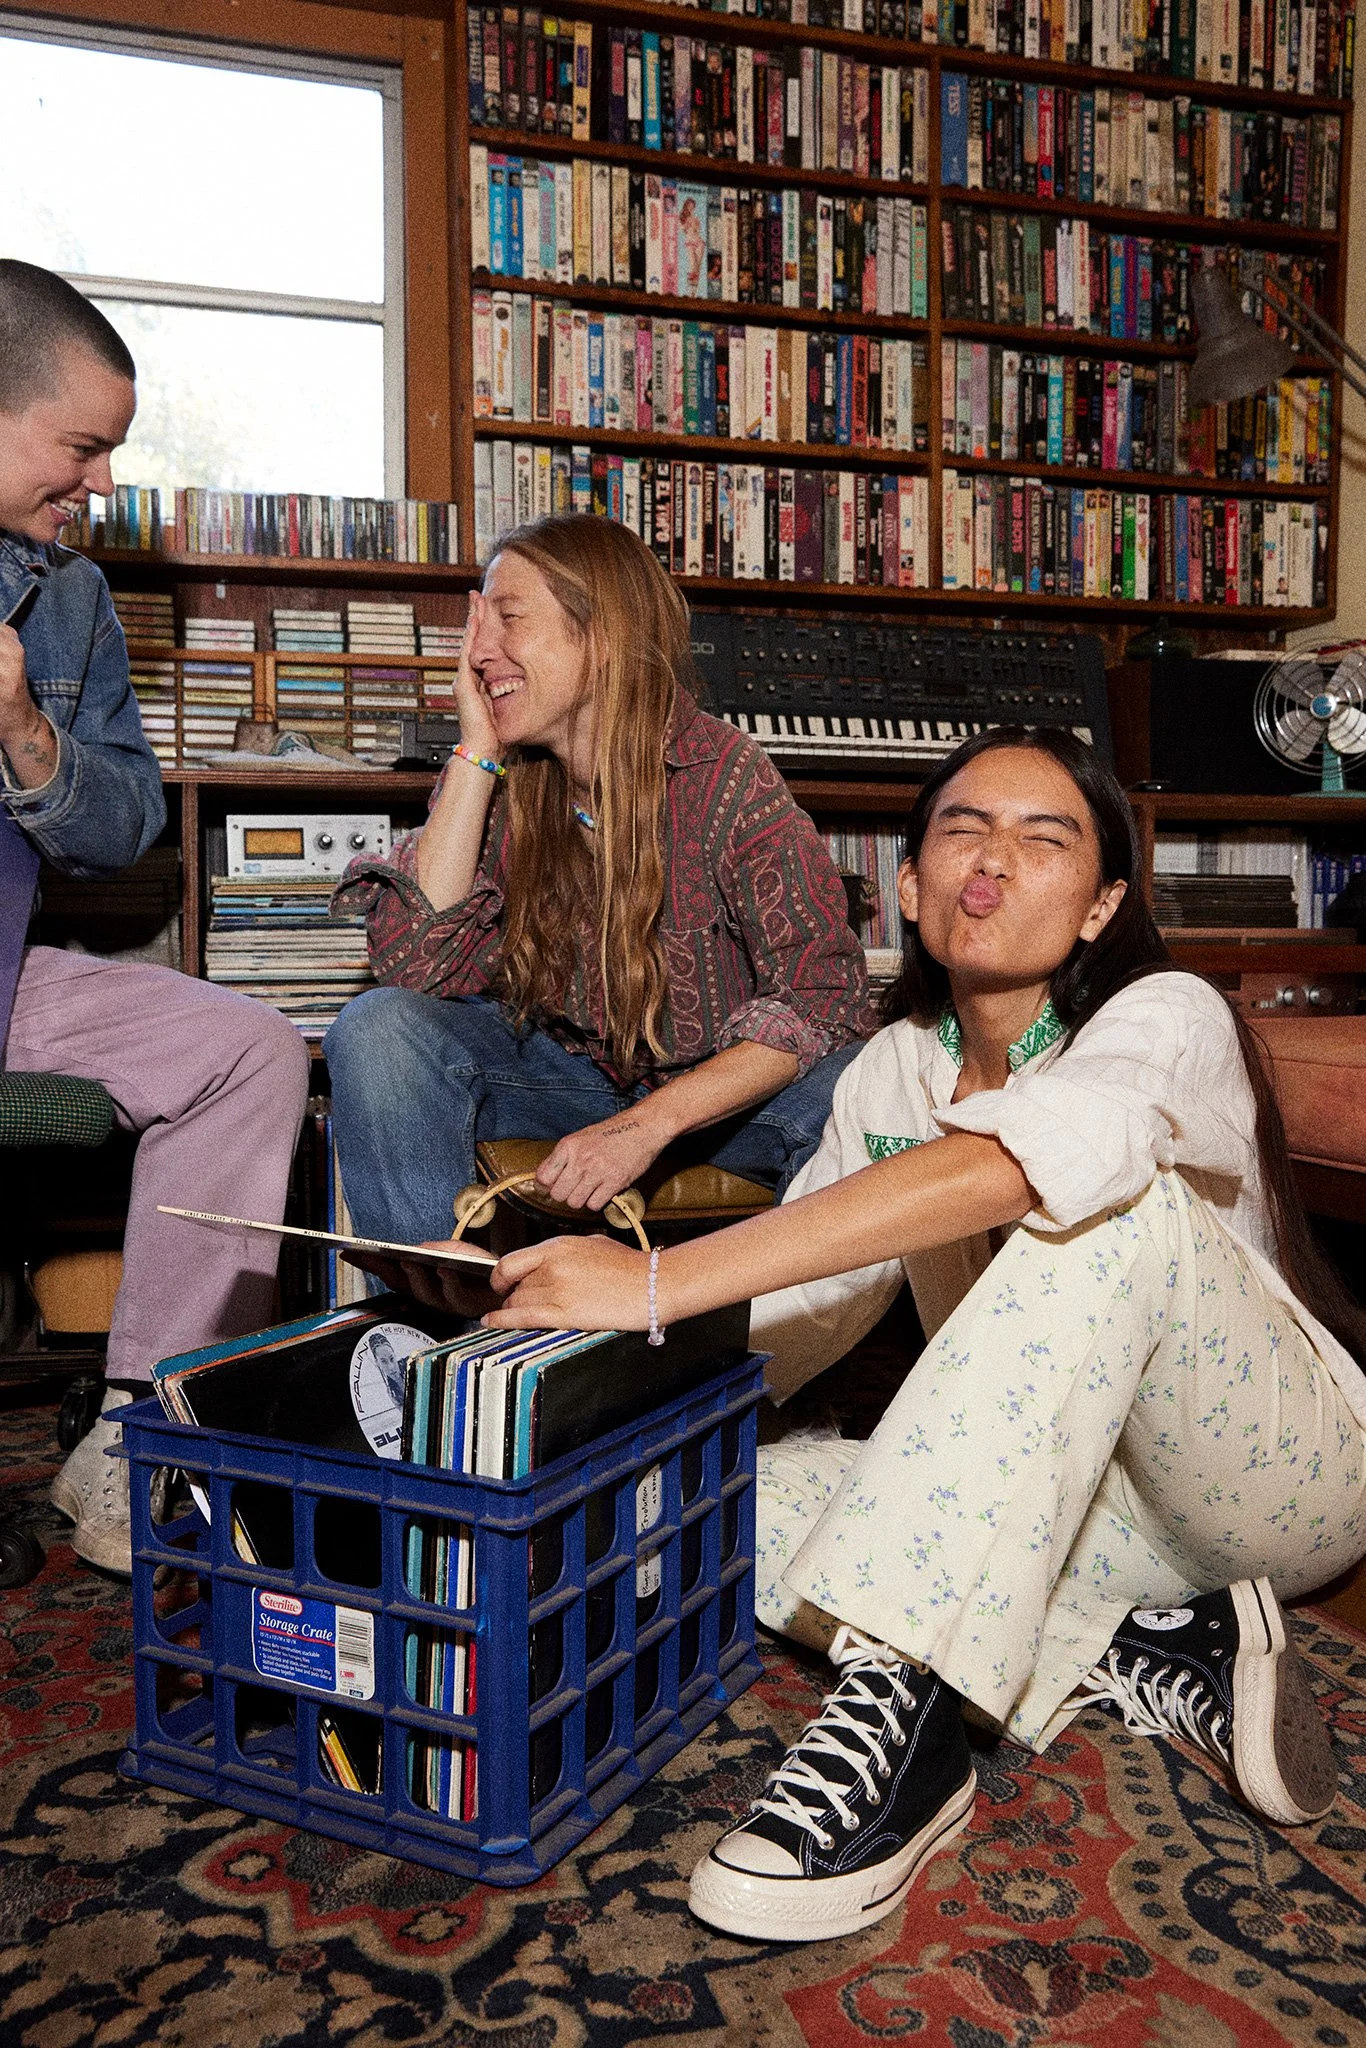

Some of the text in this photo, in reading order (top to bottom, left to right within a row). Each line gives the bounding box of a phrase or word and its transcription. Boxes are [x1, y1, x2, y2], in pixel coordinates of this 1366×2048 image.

[1316, 8, 1327, 62] DUNE
[380, 1326, 392, 1334] THE
[407, 1330, 421, 1340] NEW
[263, 1595, 299, 1613] Sterilite
[259, 1613, 299, 1635] Storage
[301, 1623, 333, 1641] Crate
